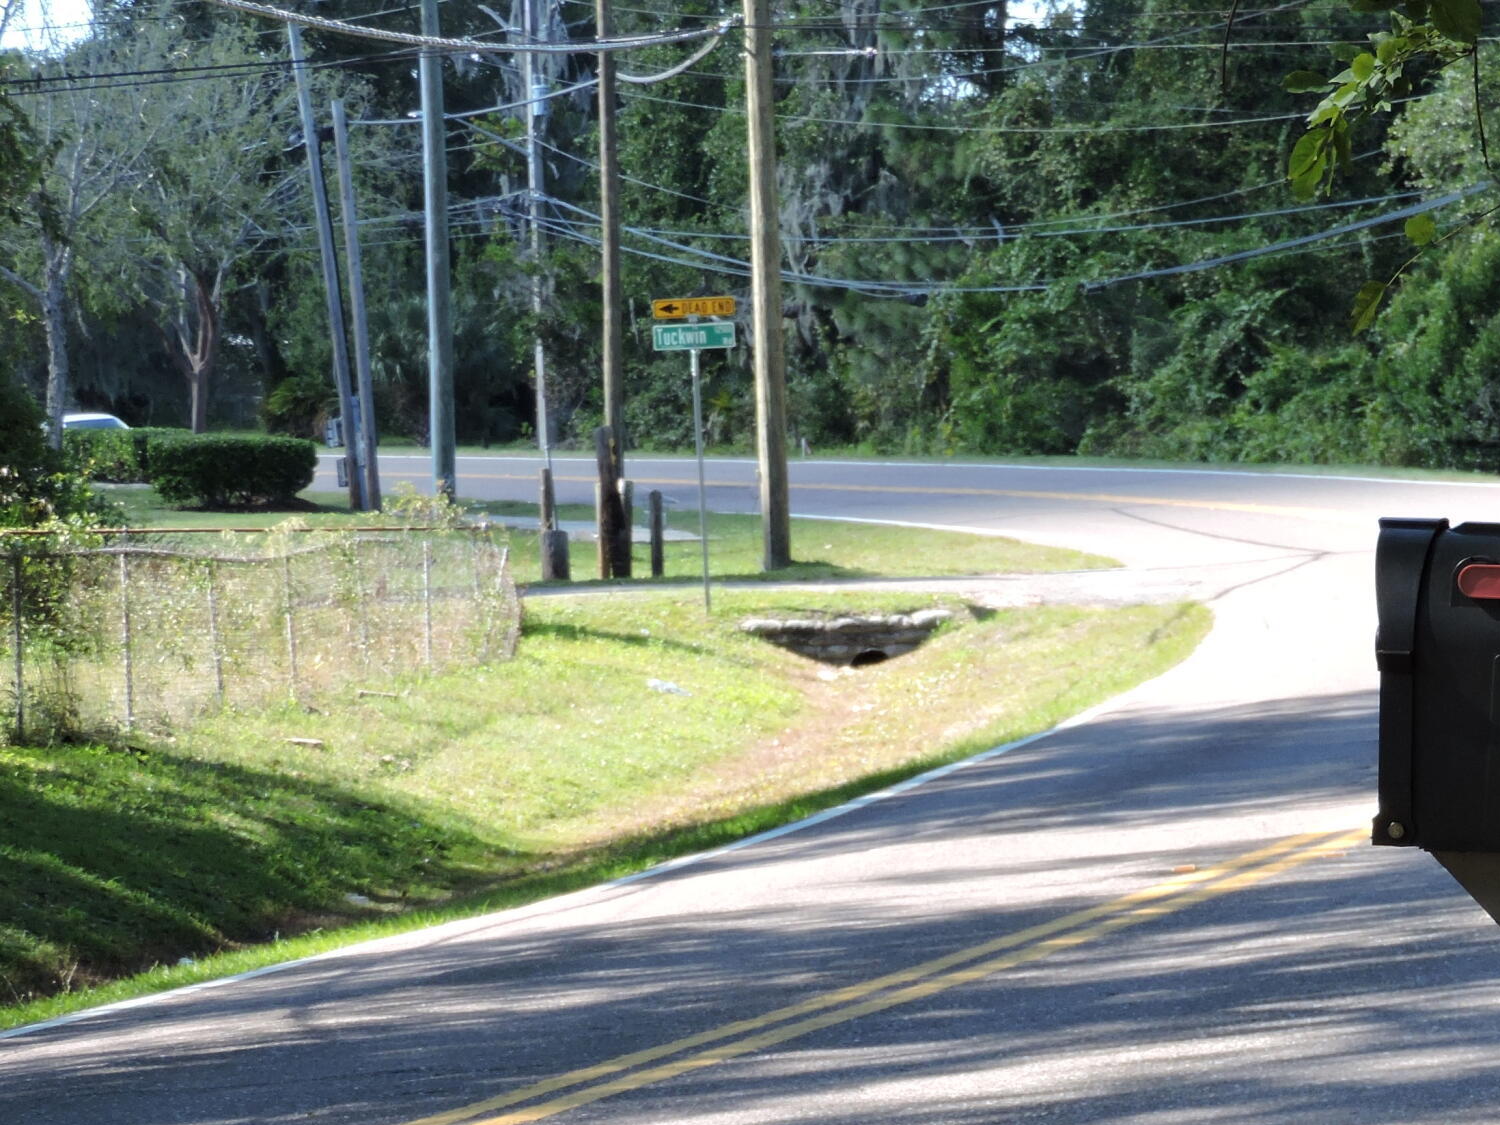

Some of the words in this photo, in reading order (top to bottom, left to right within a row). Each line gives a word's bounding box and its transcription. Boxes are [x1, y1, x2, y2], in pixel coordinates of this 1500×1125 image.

[681, 302, 707, 314] DEAD
[712, 300, 732, 312] END
[657, 328, 707, 345] Tuckwin
